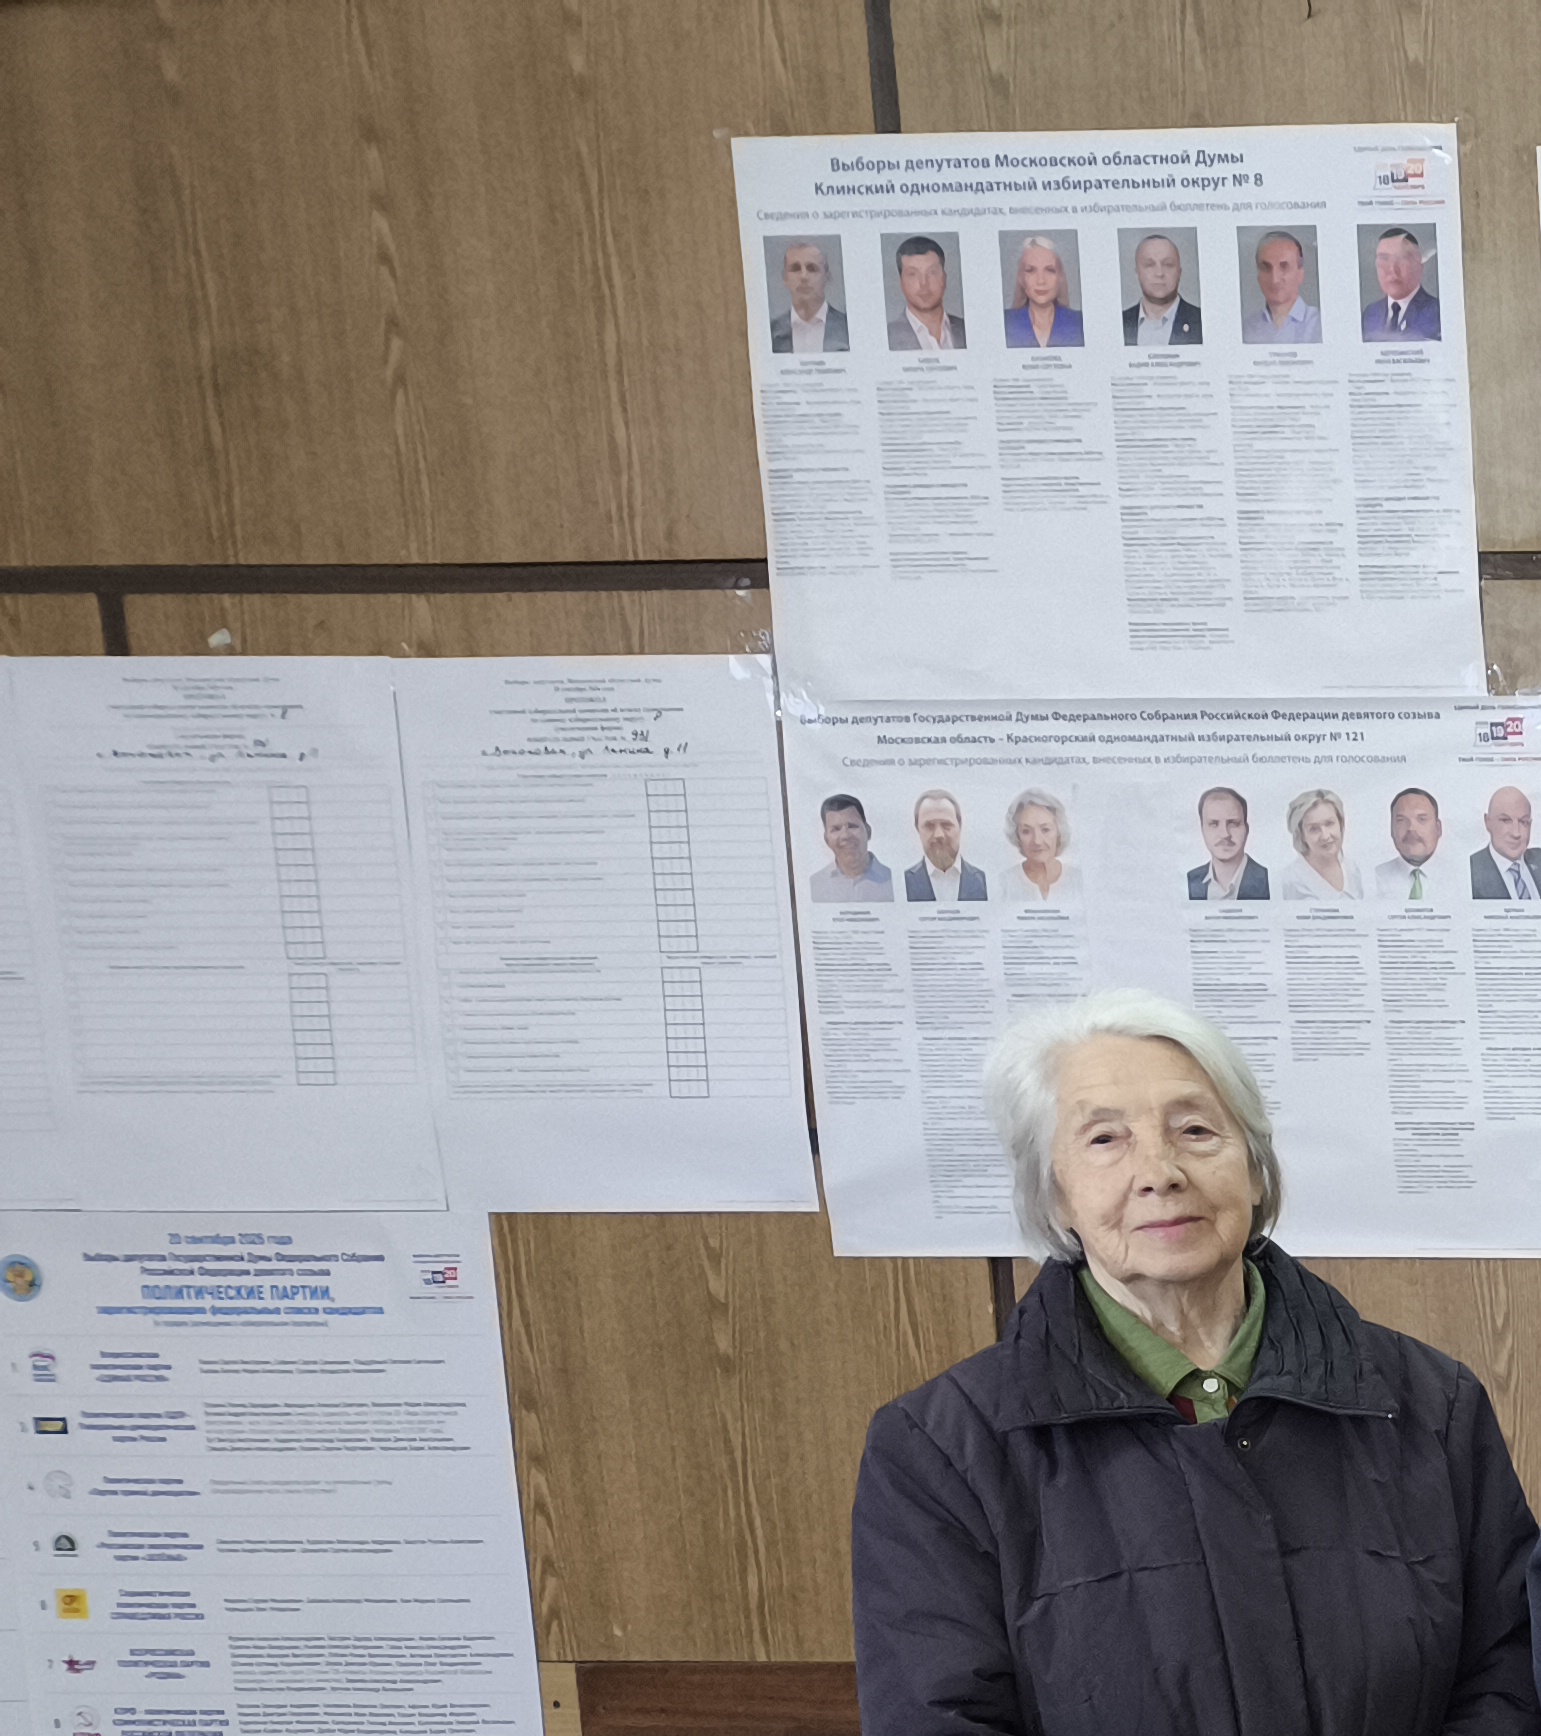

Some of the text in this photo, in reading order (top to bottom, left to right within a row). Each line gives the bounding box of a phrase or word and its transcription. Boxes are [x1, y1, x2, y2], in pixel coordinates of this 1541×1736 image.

[830, 150, 1243, 174] Выборы депутатов Московской областной Думы
[815, 173, 1263, 196] Клинский одномандатный избирательный округ № 8
[851, 714, 910, 726] депутатов
[913, 711, 1012, 724] Государственной
[1015, 711, 1049, 724] Думы
[1051, 711, 1137, 723] Федерального
[1140, 710, 1198, 722] Собрания
[1200, 709, 1268, 721] Российской
[1271, 709, 1338, 721] Федерации
[1342, 711, 1395, 722] девятого
[1398, 711, 1440, 720] созыва
[877, 731, 1365, 745] Московская область Красногорский одномандатный избирательный округ № 121
[141, 1284, 264, 1300] ПОЛИТИЧЕСКИЕ
